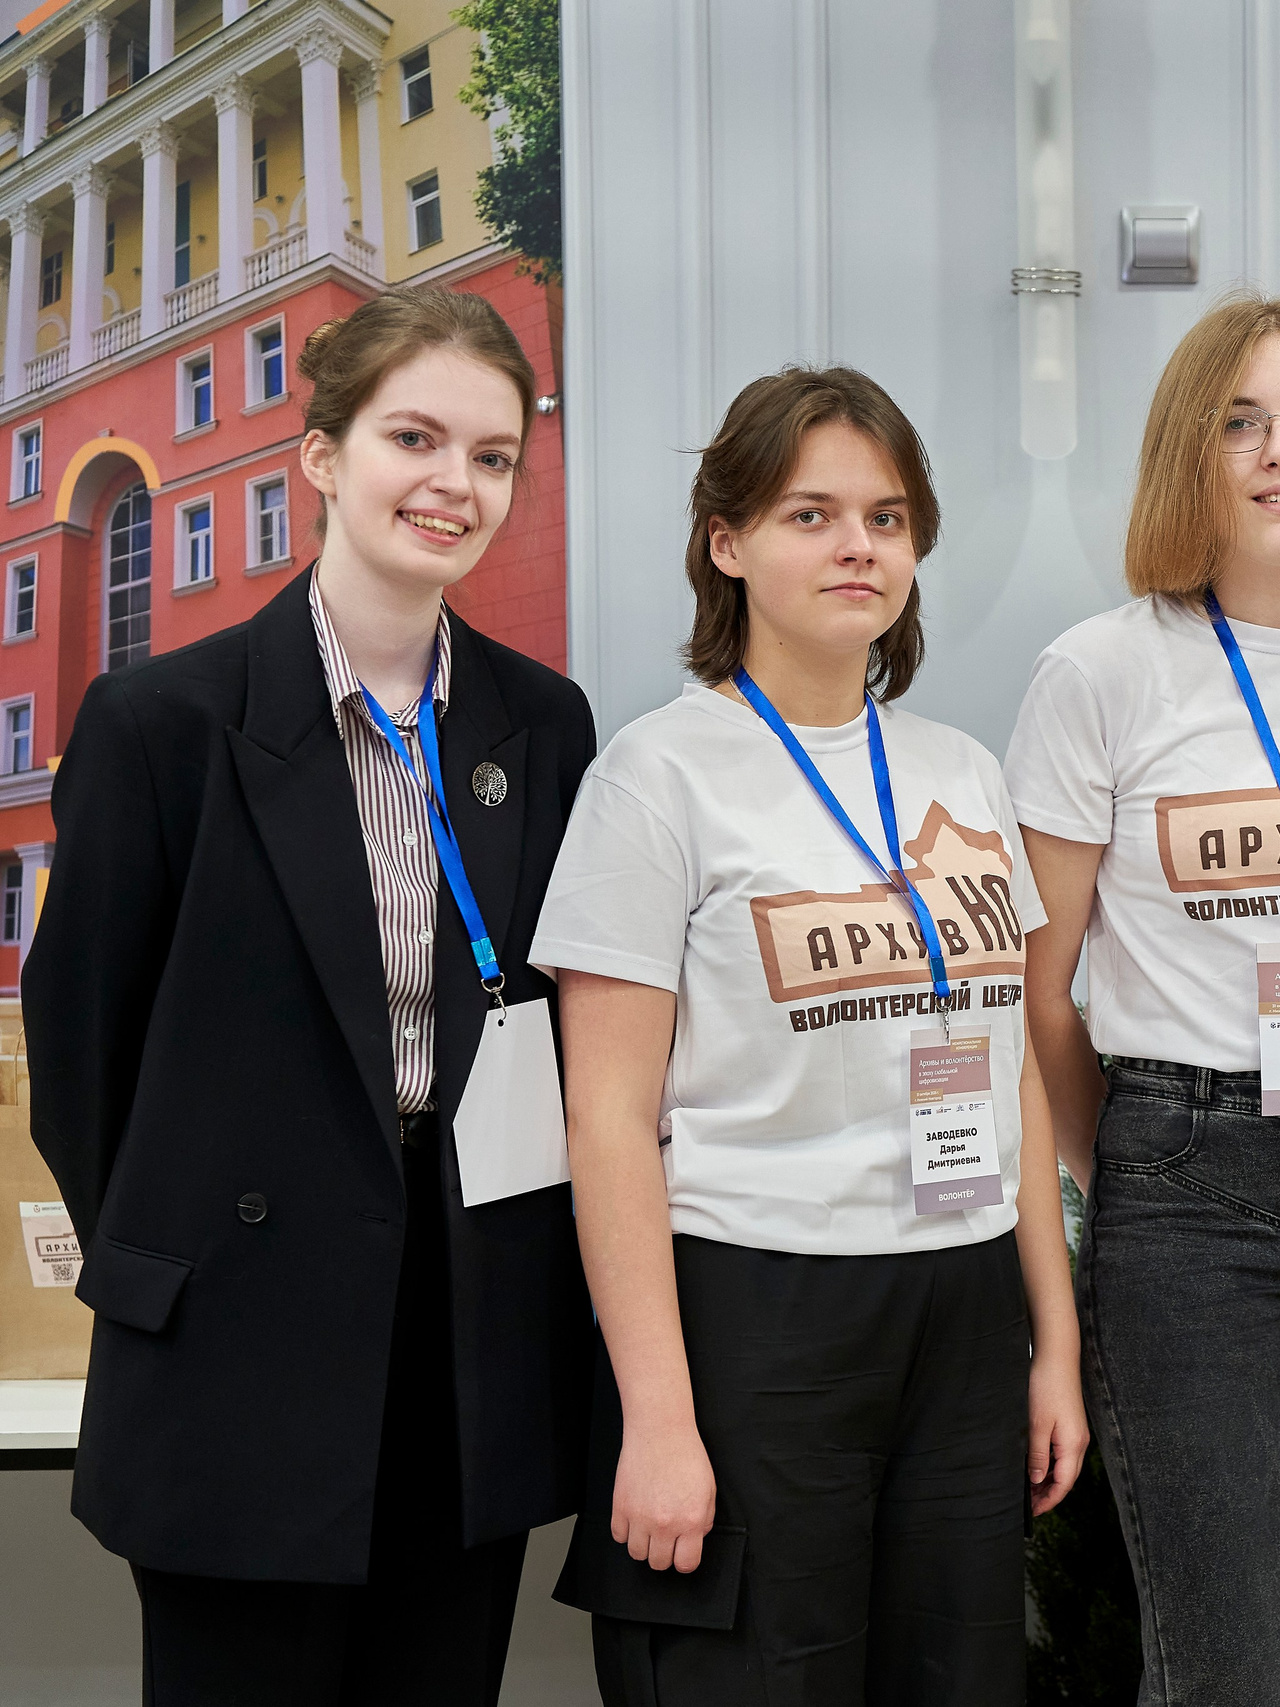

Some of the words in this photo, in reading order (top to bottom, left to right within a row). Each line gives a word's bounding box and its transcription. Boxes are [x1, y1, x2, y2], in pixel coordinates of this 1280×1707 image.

[919, 1059, 940, 1068] Архивы
[946, 1055, 984, 1066] волонтёрство
[926, 1127, 978, 1142] ЗАВОДЕВКО
[940, 1144, 966, 1155] Дарья
[928, 1155, 981, 1170] Дмитриевна
[938, 1189, 975, 1201] ВОЛОНТЁР
